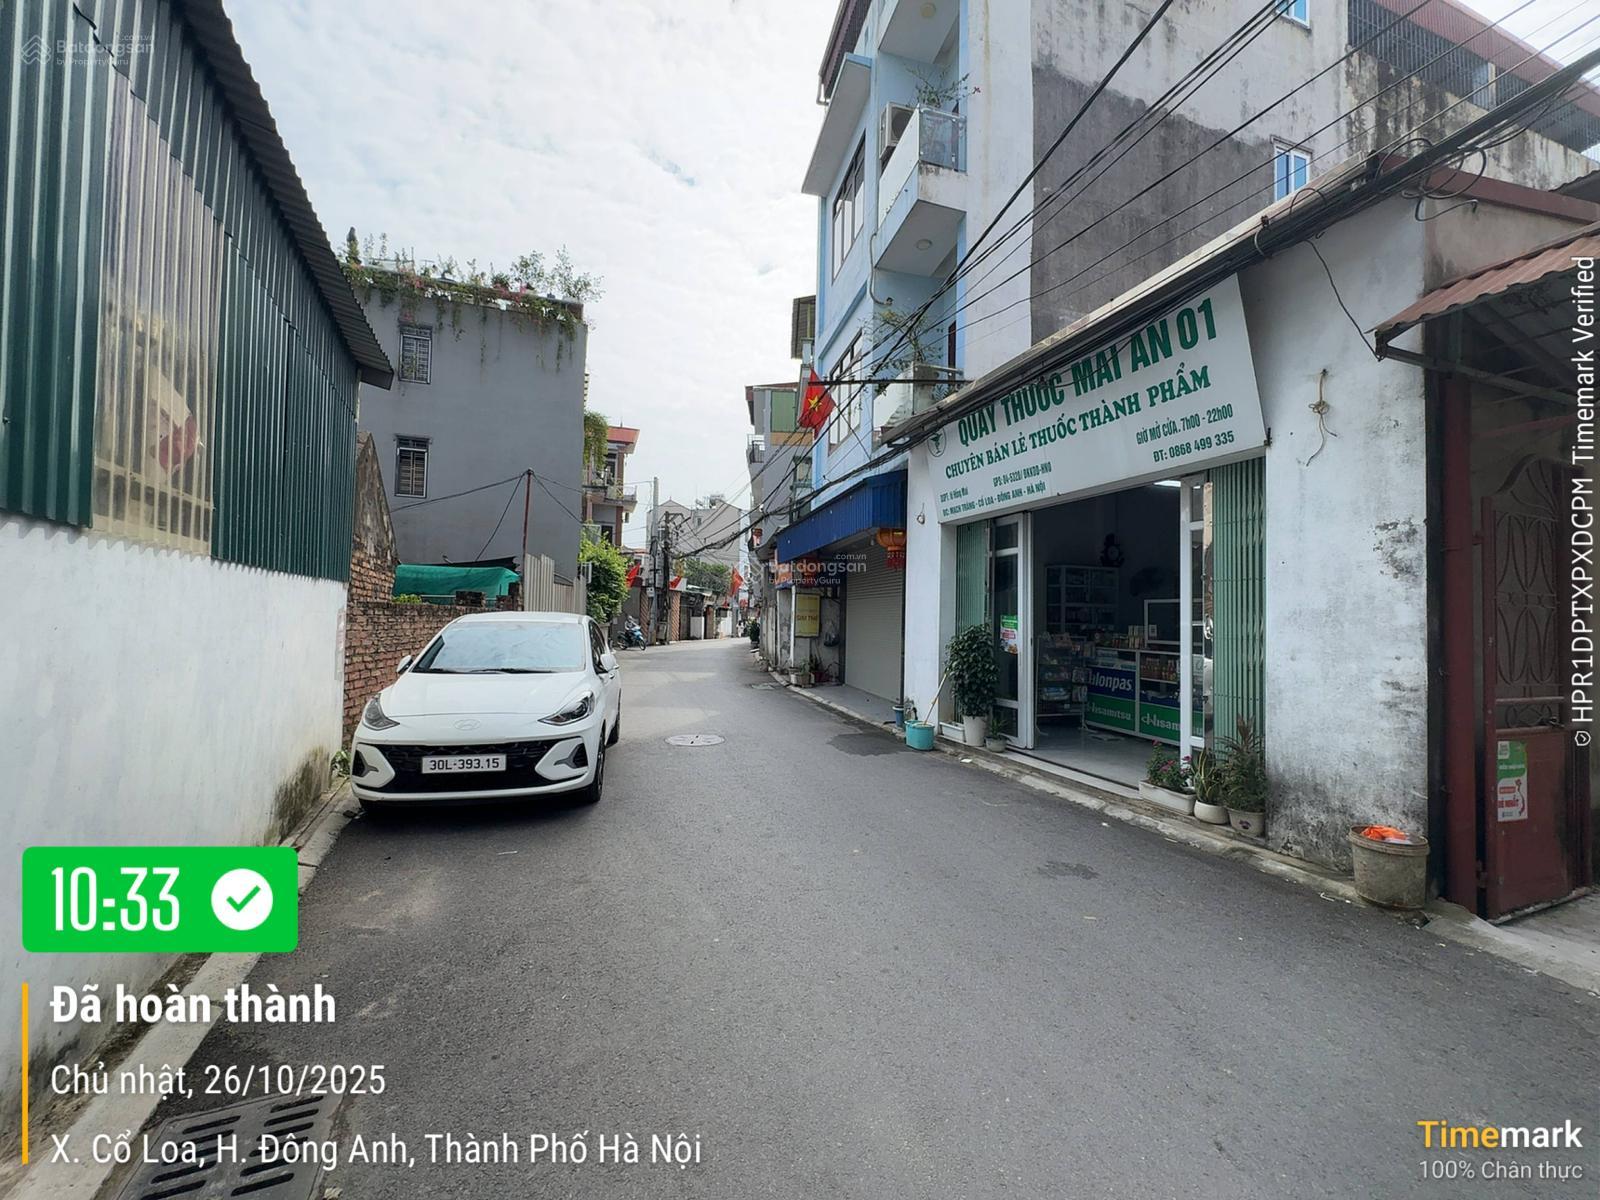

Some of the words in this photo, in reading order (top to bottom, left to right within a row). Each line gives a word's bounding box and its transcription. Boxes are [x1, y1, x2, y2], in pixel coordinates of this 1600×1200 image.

[1070, 343, 1122, 397] MAI
[1130, 319, 1173, 373] AN
[945, 452, 985, 479] CHUYÊN
[1029, 413, 1077, 450] THUỐC
[1079, 392, 1142, 432] THÀNH
[1146, 361, 1212, 407] PHẨM
[1181, 413, 1201, 431] 7h00
[1207, 403, 1234, 424] 22h00
[1153, 449, 1168, 462] ĐT:
[1169, 442, 1192, 458] 0868
[1194, 436, 1213, 451] 499
[1215, 430, 1235, 446] 335
[429, 757, 500, 770] 30L-393.15
